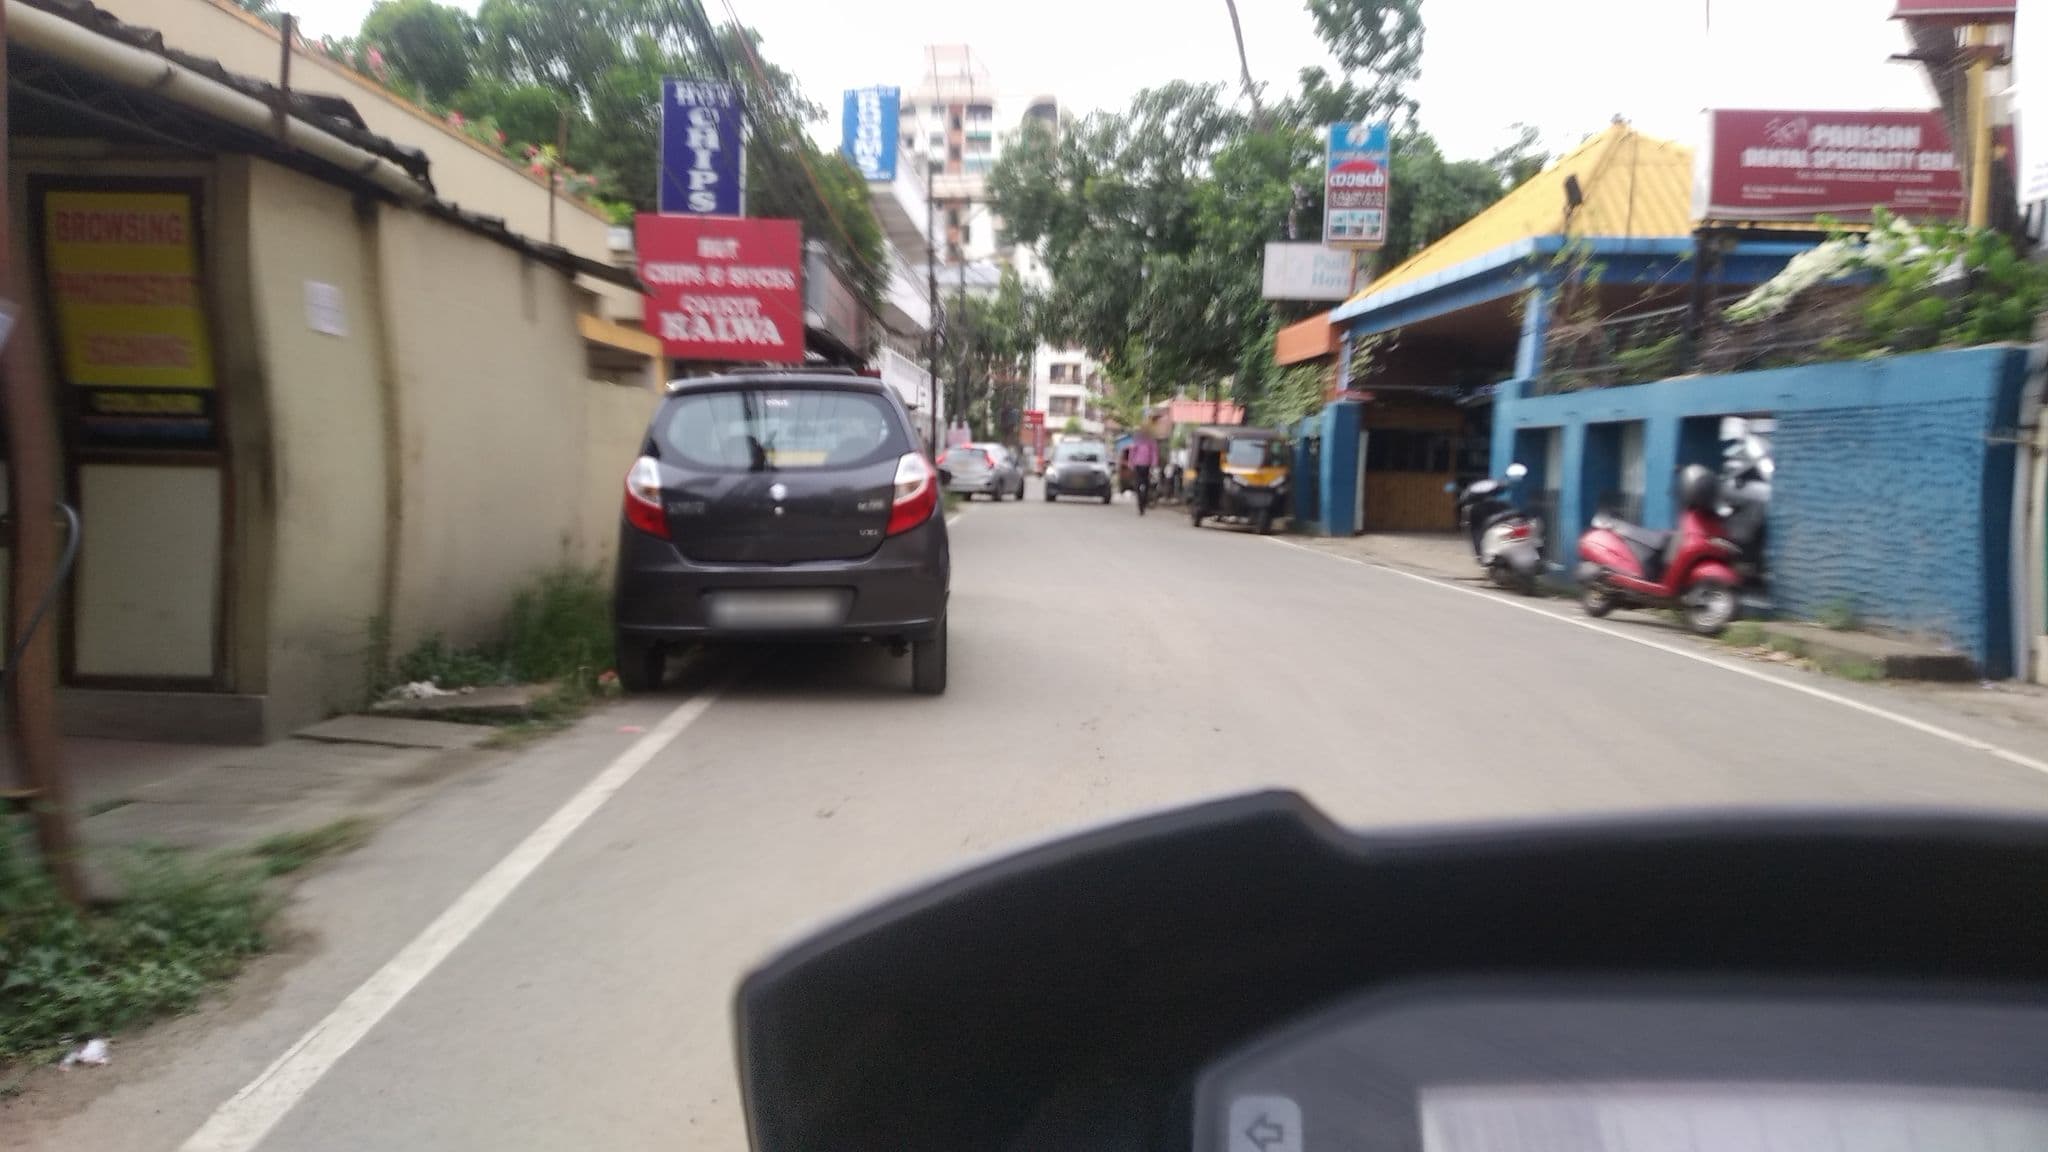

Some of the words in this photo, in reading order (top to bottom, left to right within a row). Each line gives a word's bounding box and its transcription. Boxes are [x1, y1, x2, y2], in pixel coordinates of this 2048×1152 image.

[686, 106, 720, 213] CHIPS
[1741, 147, 1808, 169] DENTAL
[56, 209, 186, 243] BROWSING
[643, 262, 705, 286] CHIPS
